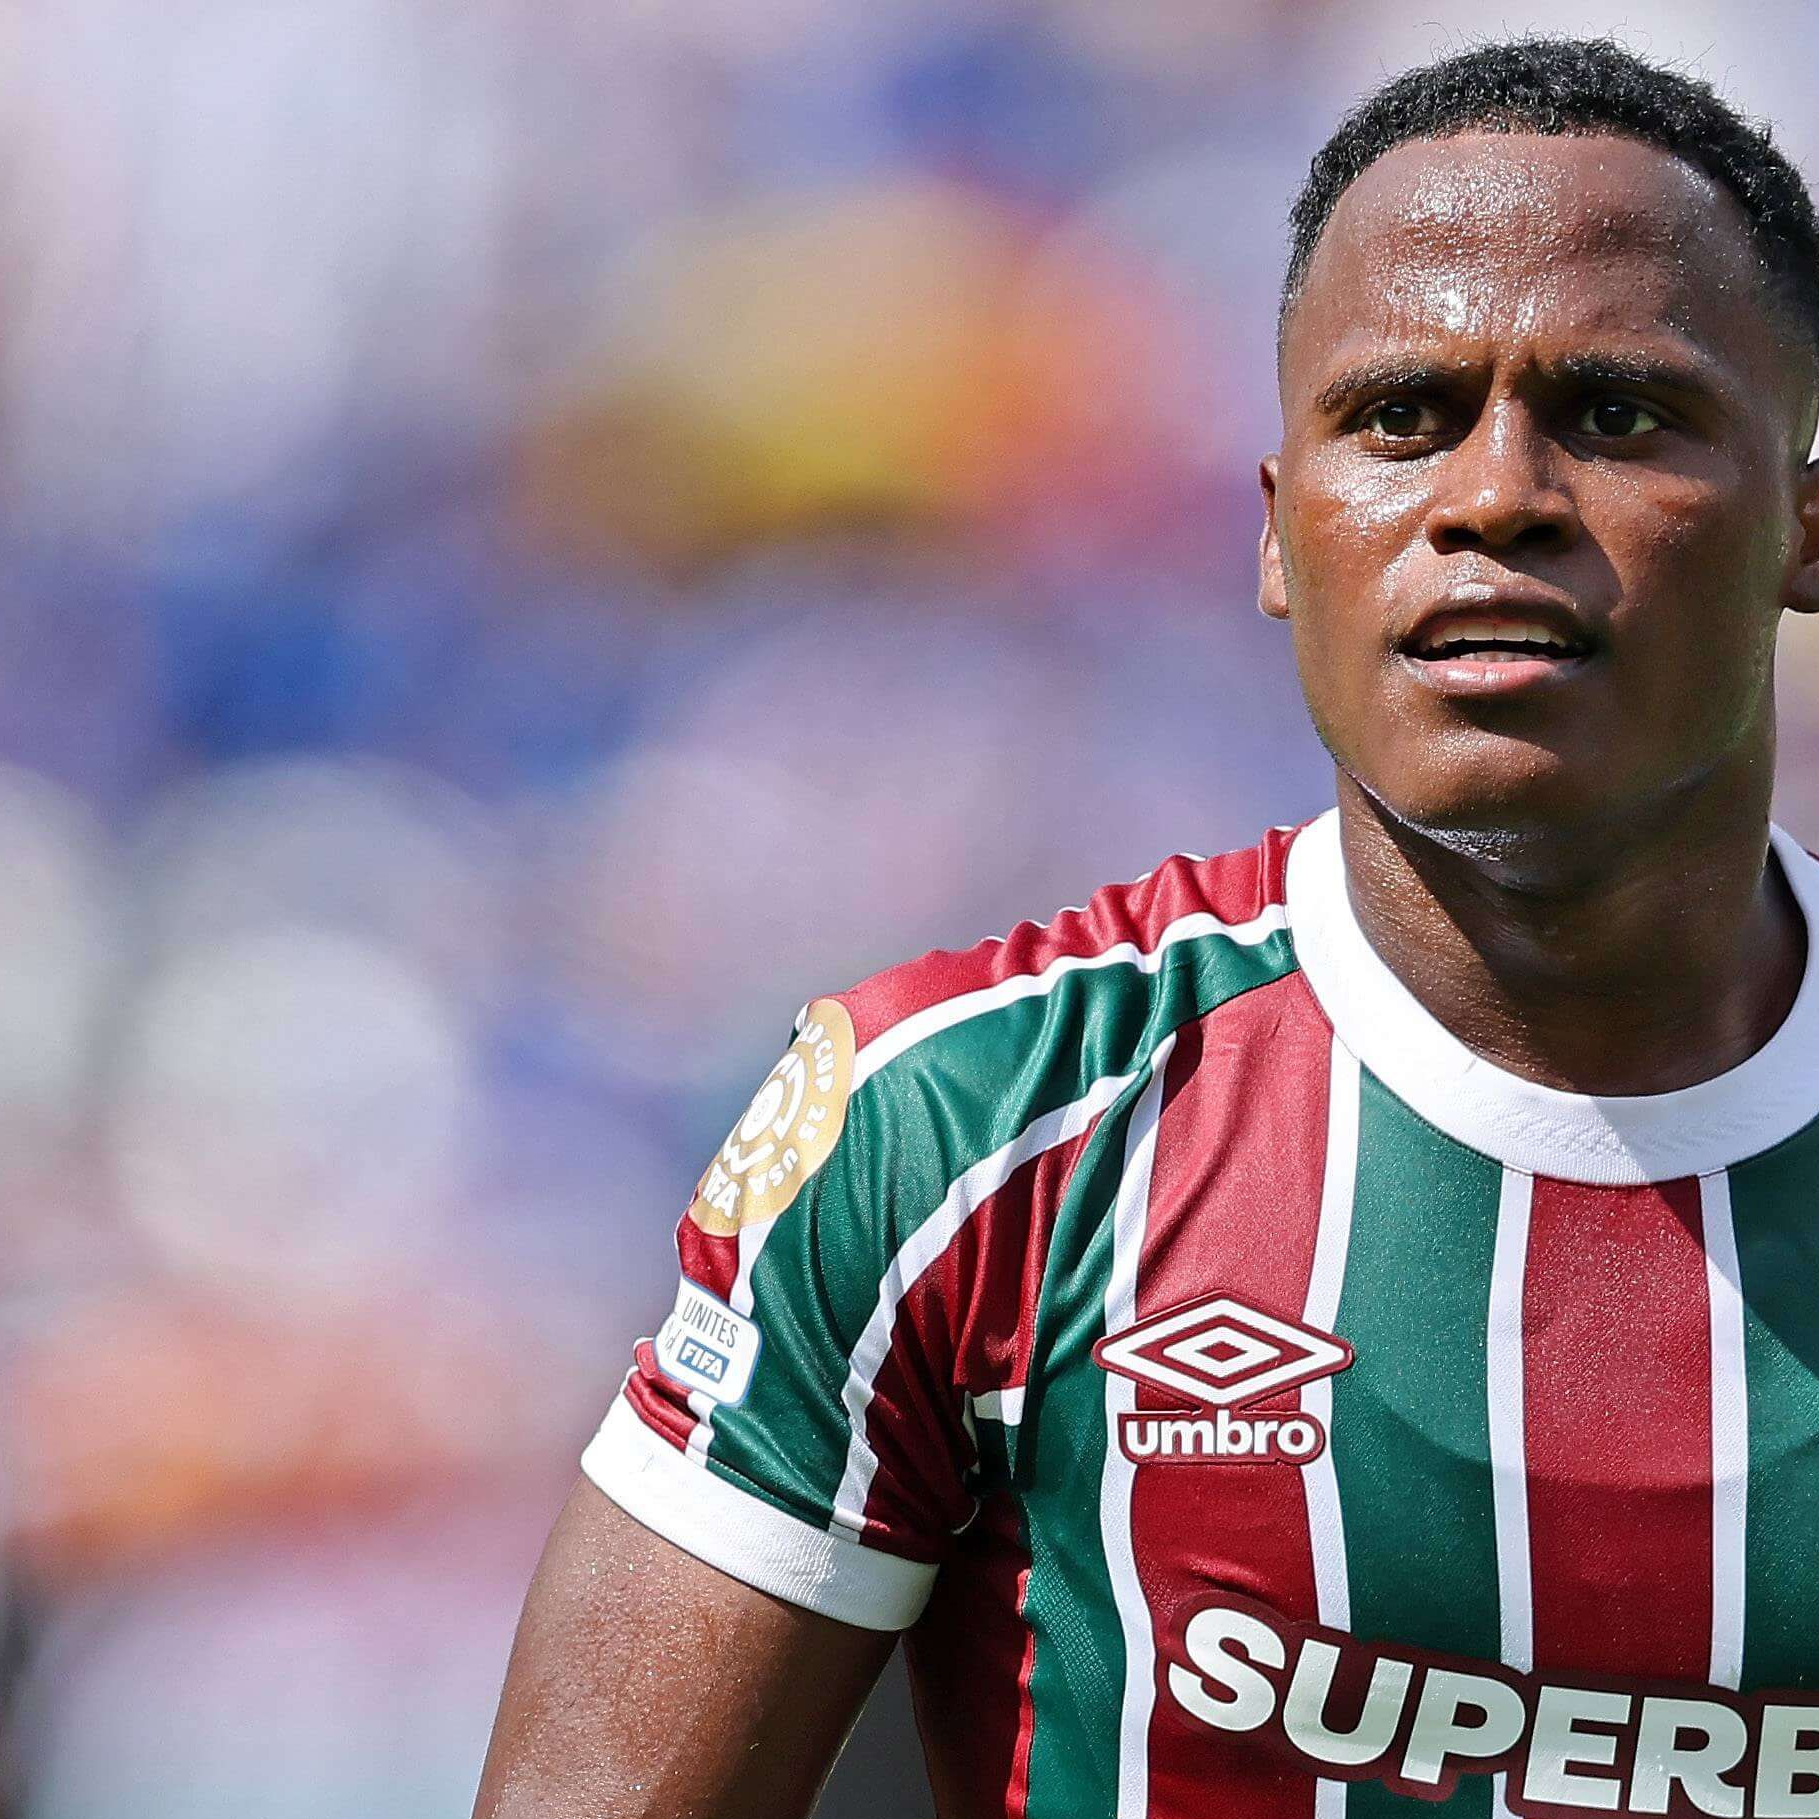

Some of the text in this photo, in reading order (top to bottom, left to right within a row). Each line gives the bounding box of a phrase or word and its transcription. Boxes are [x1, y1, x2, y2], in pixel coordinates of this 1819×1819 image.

[814, 1039, 835, 1092] CUP
[747, 1147, 799, 1196] USA
[682, 1297, 739, 1349] UNITES
[680, 1341, 725, 1380] FIFA
[1125, 1409, 1316, 1457] umbro
